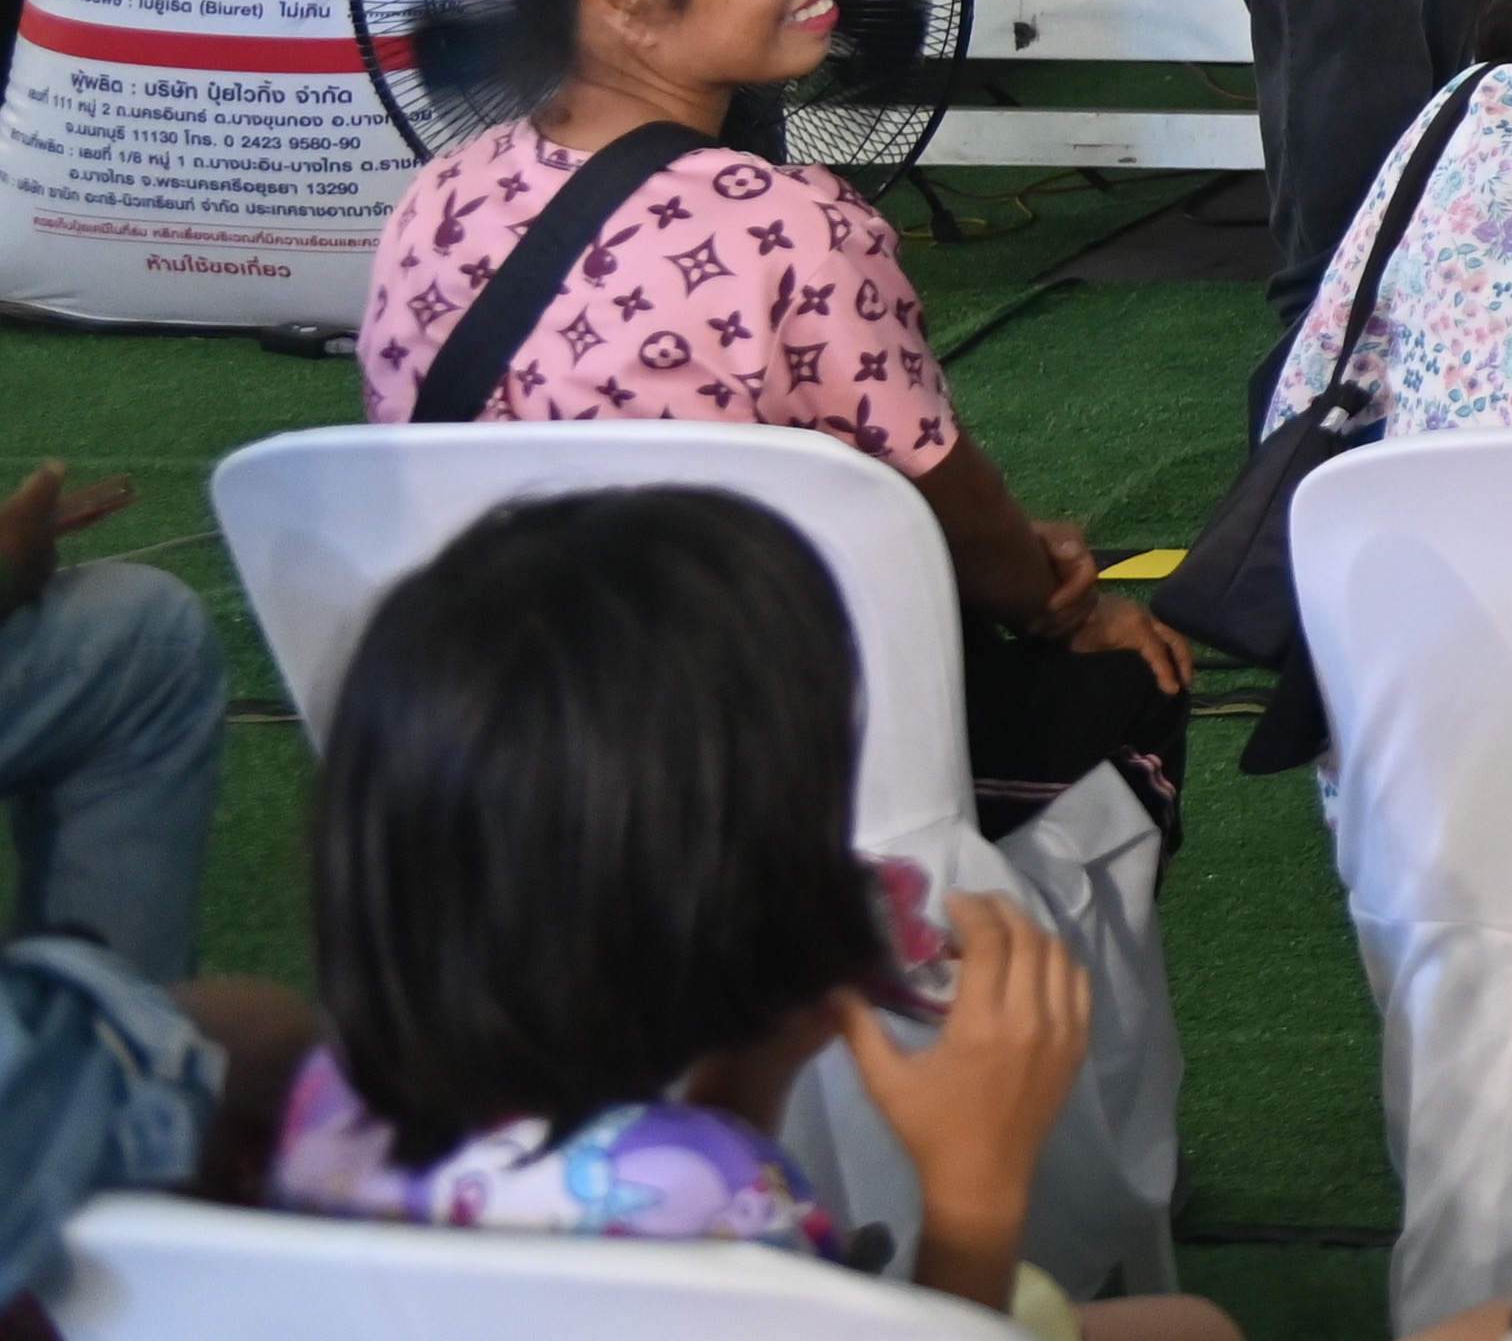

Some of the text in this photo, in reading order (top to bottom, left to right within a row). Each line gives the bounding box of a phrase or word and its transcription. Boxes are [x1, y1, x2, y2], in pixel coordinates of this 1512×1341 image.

[200, 0, 263, 19] (Biuret)
[279, 1, 331, 19] ไม่เกิน
[71, 70, 352, 106] ผู้ผลิต บริษัท ปุ๋ยไวกิ้ง จำกัด
[54, 96, 72, 110] 111
[215, 113, 323, 130] ต.บางขุนกอง
[133, 129, 178, 145] 11130
[185, 130, 217, 147] โทร.
[242, 136, 282, 149] 2423
[289, 137, 361, 150] 9580-90
[119, 151, 142, 164] 1/8
[307, 183, 359, 195] 13290
[147, 254, 291, 278] ห้ามใช้ขอเกี่ยว
